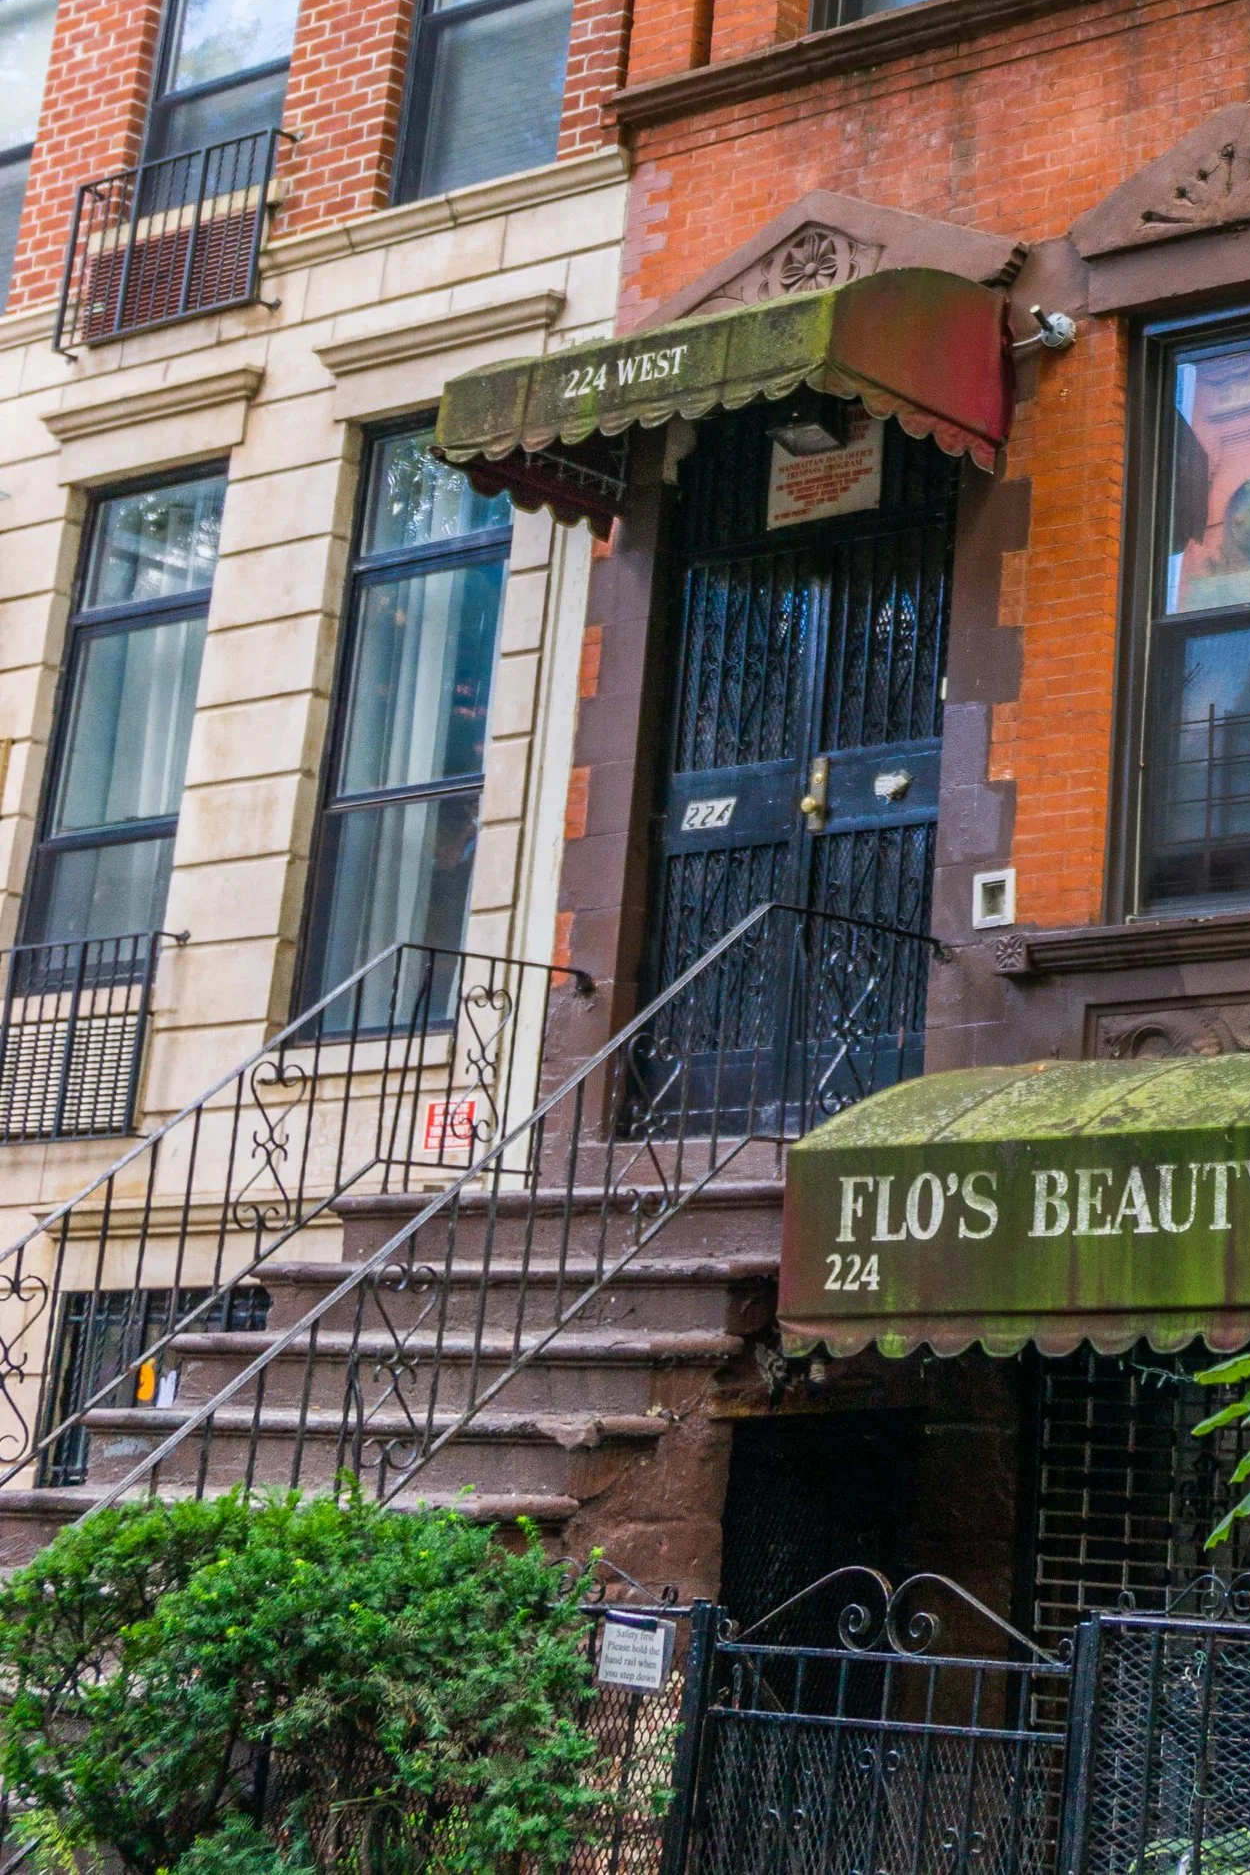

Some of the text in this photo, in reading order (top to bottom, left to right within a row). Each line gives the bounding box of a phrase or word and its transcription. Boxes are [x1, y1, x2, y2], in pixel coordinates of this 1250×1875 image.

[563, 345, 688, 399] 224 WEST
[686, 803, 732, 828] 224
[835, 1171, 999, 1243] FLO'S
[823, 1253, 881, 1292] 224
[616, 1629, 639, 1642] Safety
[607, 1640, 660, 1656] Please hold the
[604, 1654, 657, 1669] hand rail when
[604, 1669, 656, 1683] you step down
